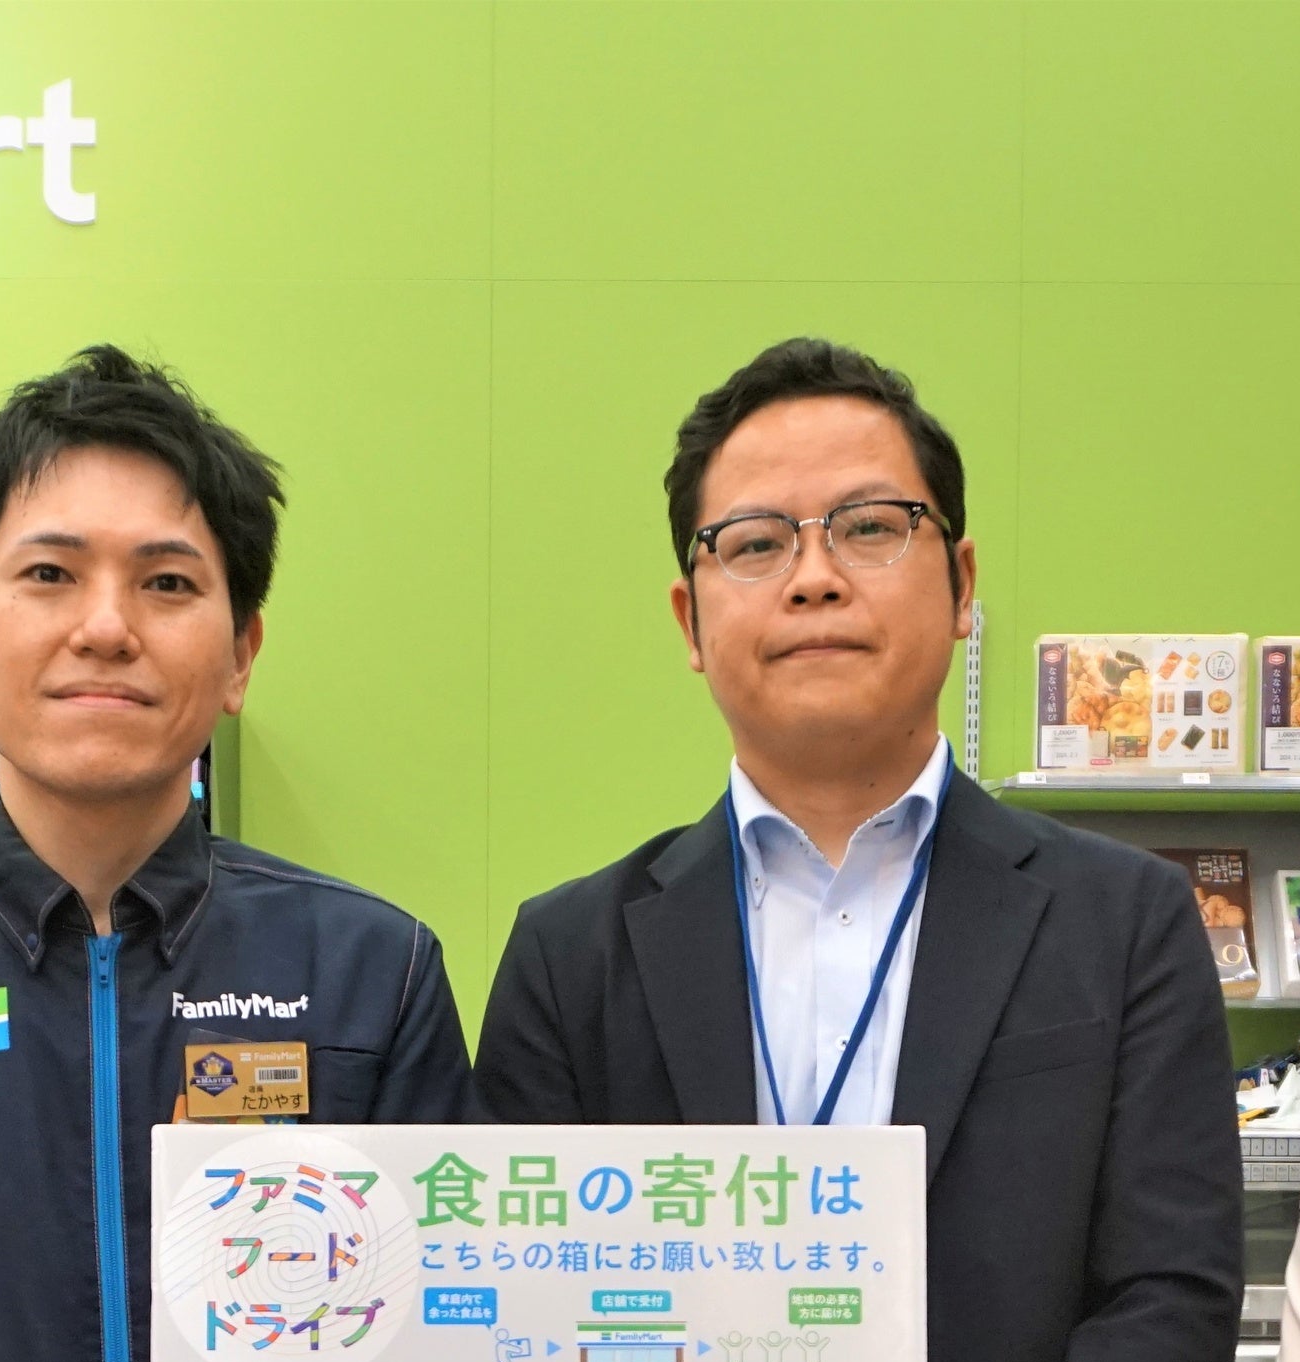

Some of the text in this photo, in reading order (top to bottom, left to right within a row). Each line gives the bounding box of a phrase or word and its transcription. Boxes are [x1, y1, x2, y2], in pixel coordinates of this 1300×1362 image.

[172, 991, 309, 1020] FamilyMart
[253, 1050, 301, 1061] FamilyMart
[241, 1094, 304, 1110] たかやす
[203, 1165, 380, 1215] ファミマ
[412, 1150, 864, 1229] 食品の寄付は
[221, 1231, 363, 1283] フード
[419, 1240, 887, 1275] こちらの箱にお願い致します。
[601, 1295, 664, 1309] 店舗で受付
[792, 1293, 860, 1307] 地域の必要な
[428, 1307, 493, 1320] 余った食品を
[798, 1307, 854, 1320] 方に届ける
[205, 1296, 386, 1354] ドライブ
[614, 1331, 663, 1343] FamilyMart
